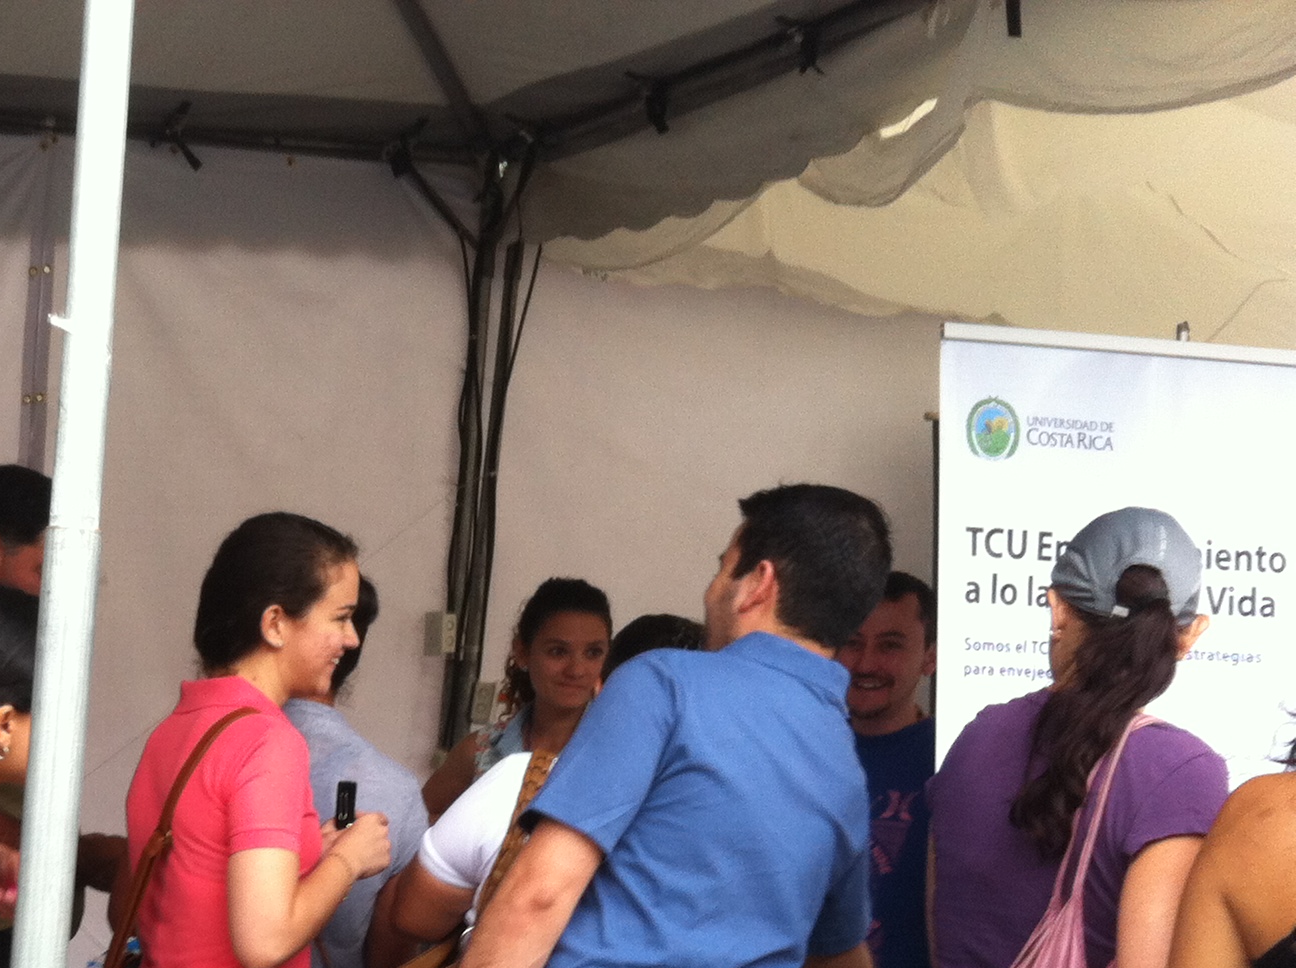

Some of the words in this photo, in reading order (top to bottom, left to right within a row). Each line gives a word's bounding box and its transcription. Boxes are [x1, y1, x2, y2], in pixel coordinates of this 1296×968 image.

[1026, 415, 1098, 432] UNIVERSIDAD
[1100, 420, 1115, 433] DE
[1026, 427, 1074, 449] COSTA
[1076, 431, 1114, 451] RICA
[966, 527, 1028, 560] TCU
[964, 581, 980, 604] a
[991, 573, 1018, 606] lo
[1027, 575, 1050, 609] la
[1206, 586, 1276, 618] Vida
[964, 637, 1011, 652] Somos
[1015, 640, 1027, 653] el
[1186, 649, 1262, 666] strategias
[964, 664, 994, 677] para
